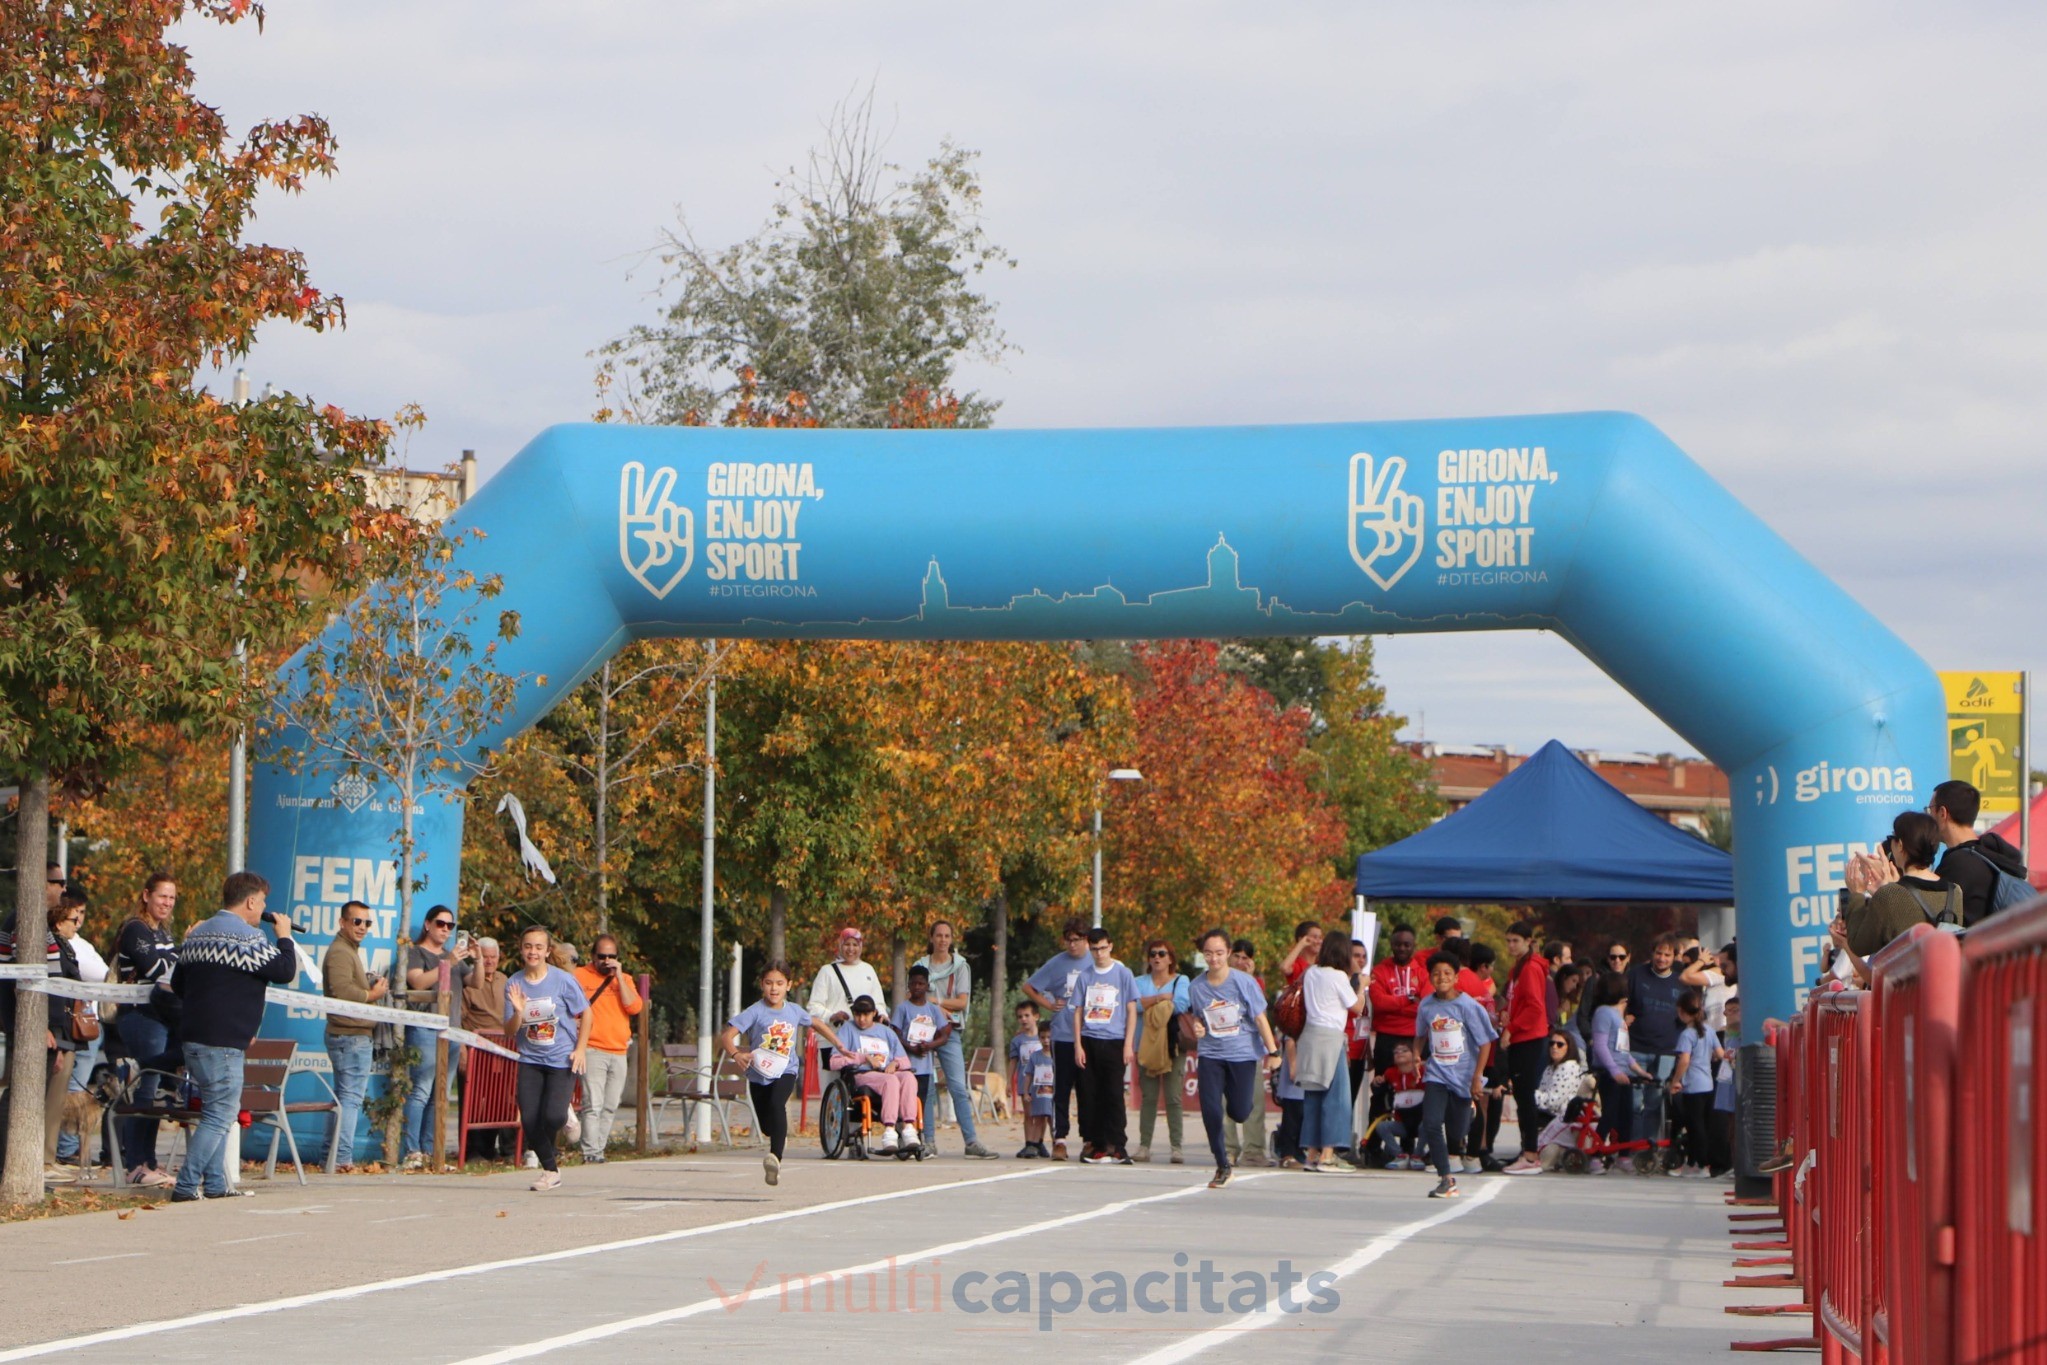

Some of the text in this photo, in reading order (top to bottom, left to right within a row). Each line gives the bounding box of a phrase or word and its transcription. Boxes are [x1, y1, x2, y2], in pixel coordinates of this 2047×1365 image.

[707, 462, 824, 501] GIRONA,
[1438, 447, 1558, 485] GIRONA,
[706, 500, 802, 539] ENJOY
[1437, 484, 1535, 526] ENJOY
[706, 542, 802, 580] SPORT
[1436, 527, 1535, 569] SPORT
[709, 584, 818, 598] #DTEGIRONA
[1437, 570, 1549, 586] #DTEGIRONA
[1960, 697, 1994, 708] adif
[1795, 761, 1913, 802] girona
[1856, 794, 1914, 804] emociona
[370, 800, 383, 812] de
[293, 855, 397, 906] FEM
[1786, 842, 1881, 894] FE
[292, 905, 397, 939] CIUAT
[530, 1009, 541, 1018] 66
[760, 1060, 773, 1069] 57
